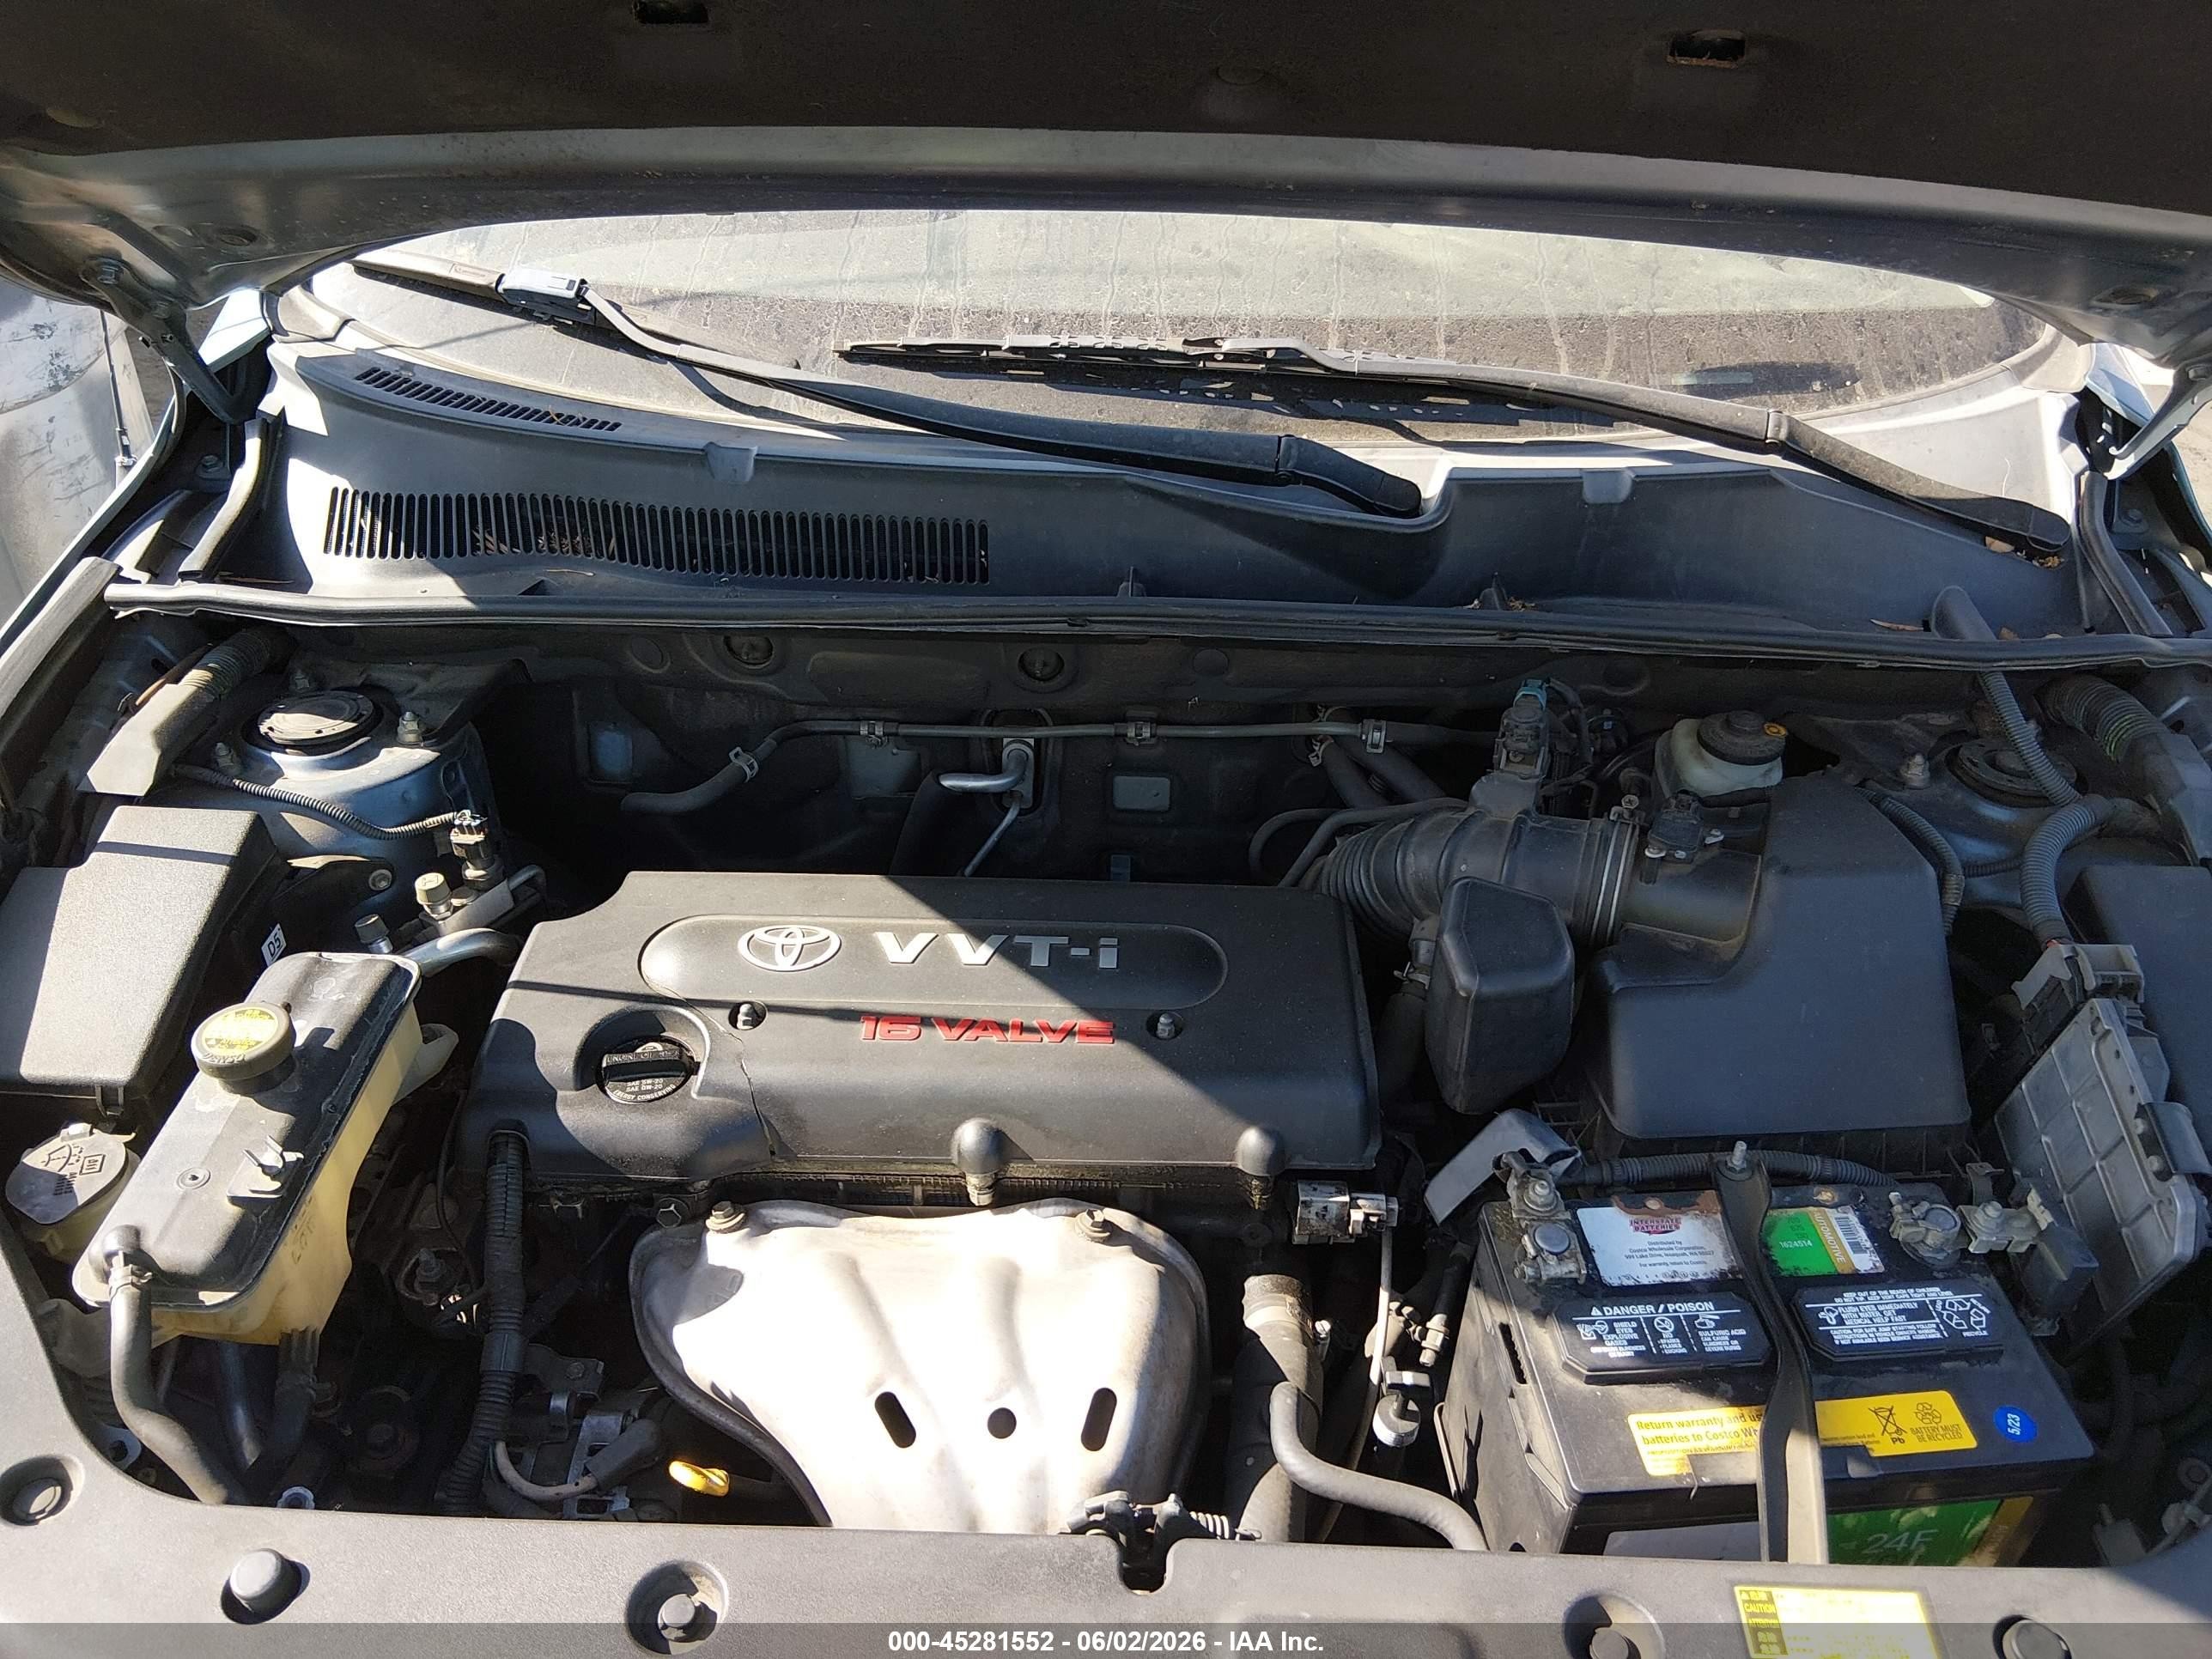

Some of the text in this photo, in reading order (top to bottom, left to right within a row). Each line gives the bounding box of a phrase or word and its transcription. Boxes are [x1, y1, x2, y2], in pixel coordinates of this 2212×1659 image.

[873, 931, 1119, 969] VVT-i
[860, 1015, 1115, 1045] 16 VALVE
[636, 1084, 677, 1101] CONSERVING
[1630, 1217, 1681, 1226] INTERSTATE
[1634, 1223, 1680, 1231] BATTERIES
[1779, 1239, 1813, 1249] 1624514
[1813, 1211, 1846, 1264] AUTOMOTIVE
[1602, 1304, 1656, 1316] DANGER
[1667, 1301, 1715, 1313] POISON
[1636, 1419, 1674, 1431] Return
[1675, 1415, 1724, 1429] warranty
[1726, 1413, 1745, 1425] and
[1940, 1424, 1961, 1432] MUST
[2007, 1413, 2021, 1436] 5/23
[1642, 1434, 1690, 1445] batteries
[1692, 1432, 1704, 1443] to
[1705, 1430, 1741, 1442] Costco
[1891, 1437, 1905, 1445] Pb
[1927, 1431, 1963, 1443] RECYCLED
[1743, 1602, 1778, 1614] CAUTION
